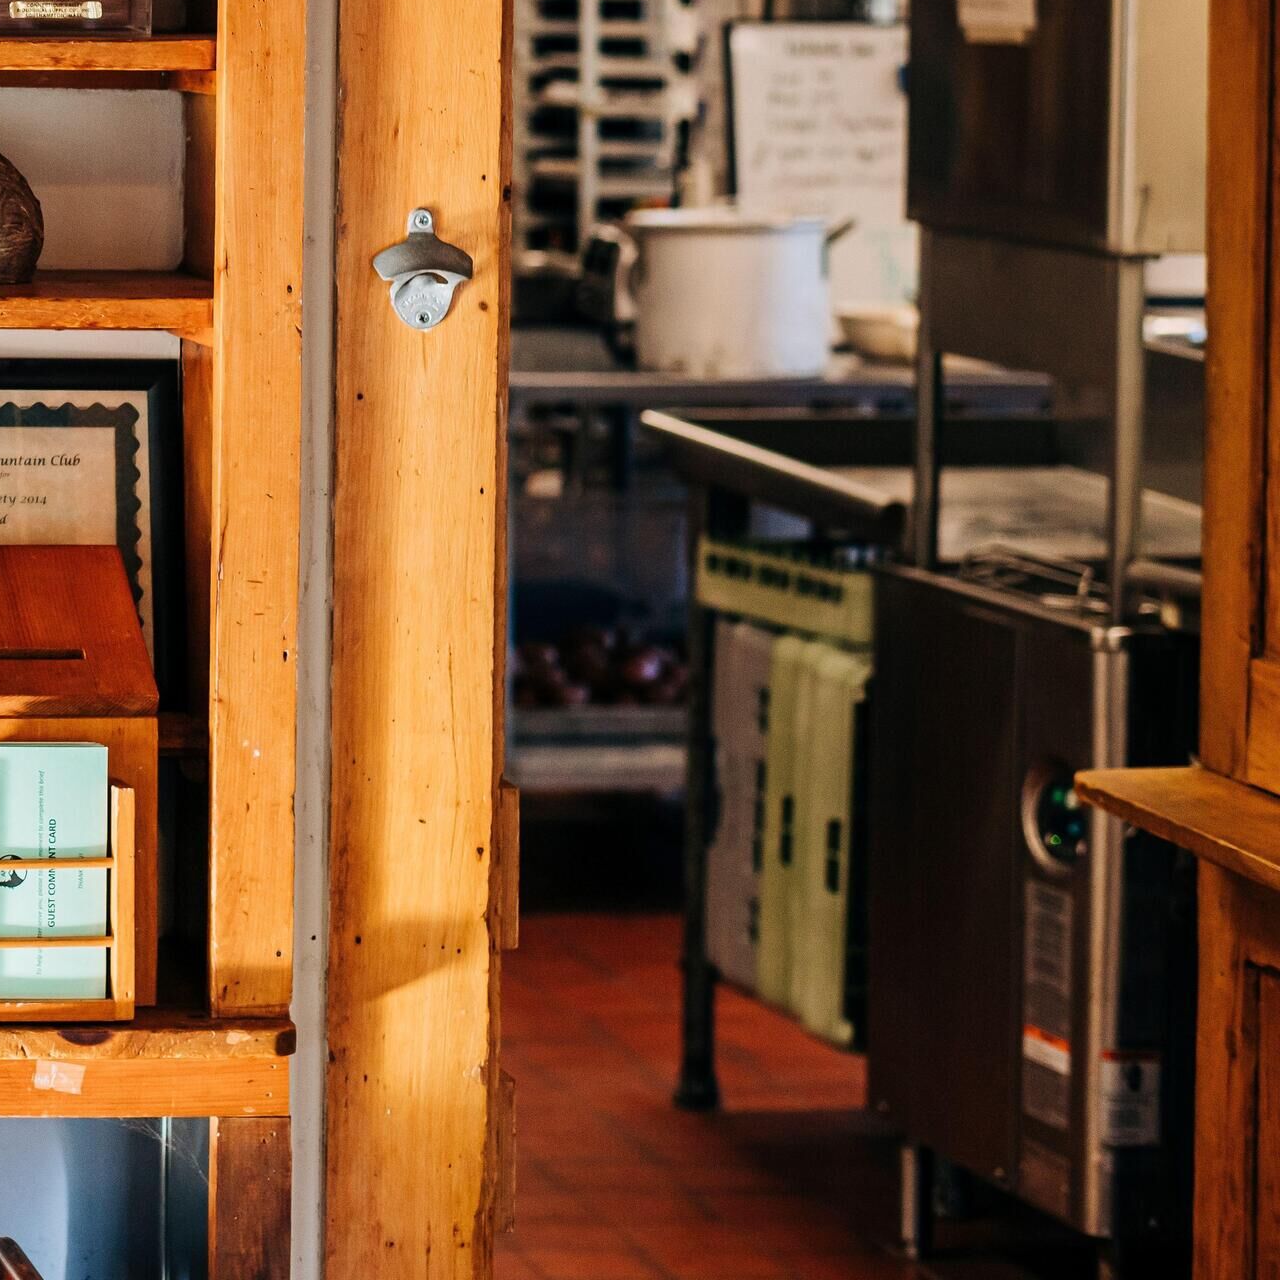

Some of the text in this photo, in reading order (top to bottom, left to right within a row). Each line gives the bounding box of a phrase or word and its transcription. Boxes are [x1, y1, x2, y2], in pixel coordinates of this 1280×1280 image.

[50, 453, 81, 467] Club
[19, 495, 47, 506] 2014
[47, 818, 58, 844] CARD
[47, 898, 57, 928] GUEST
